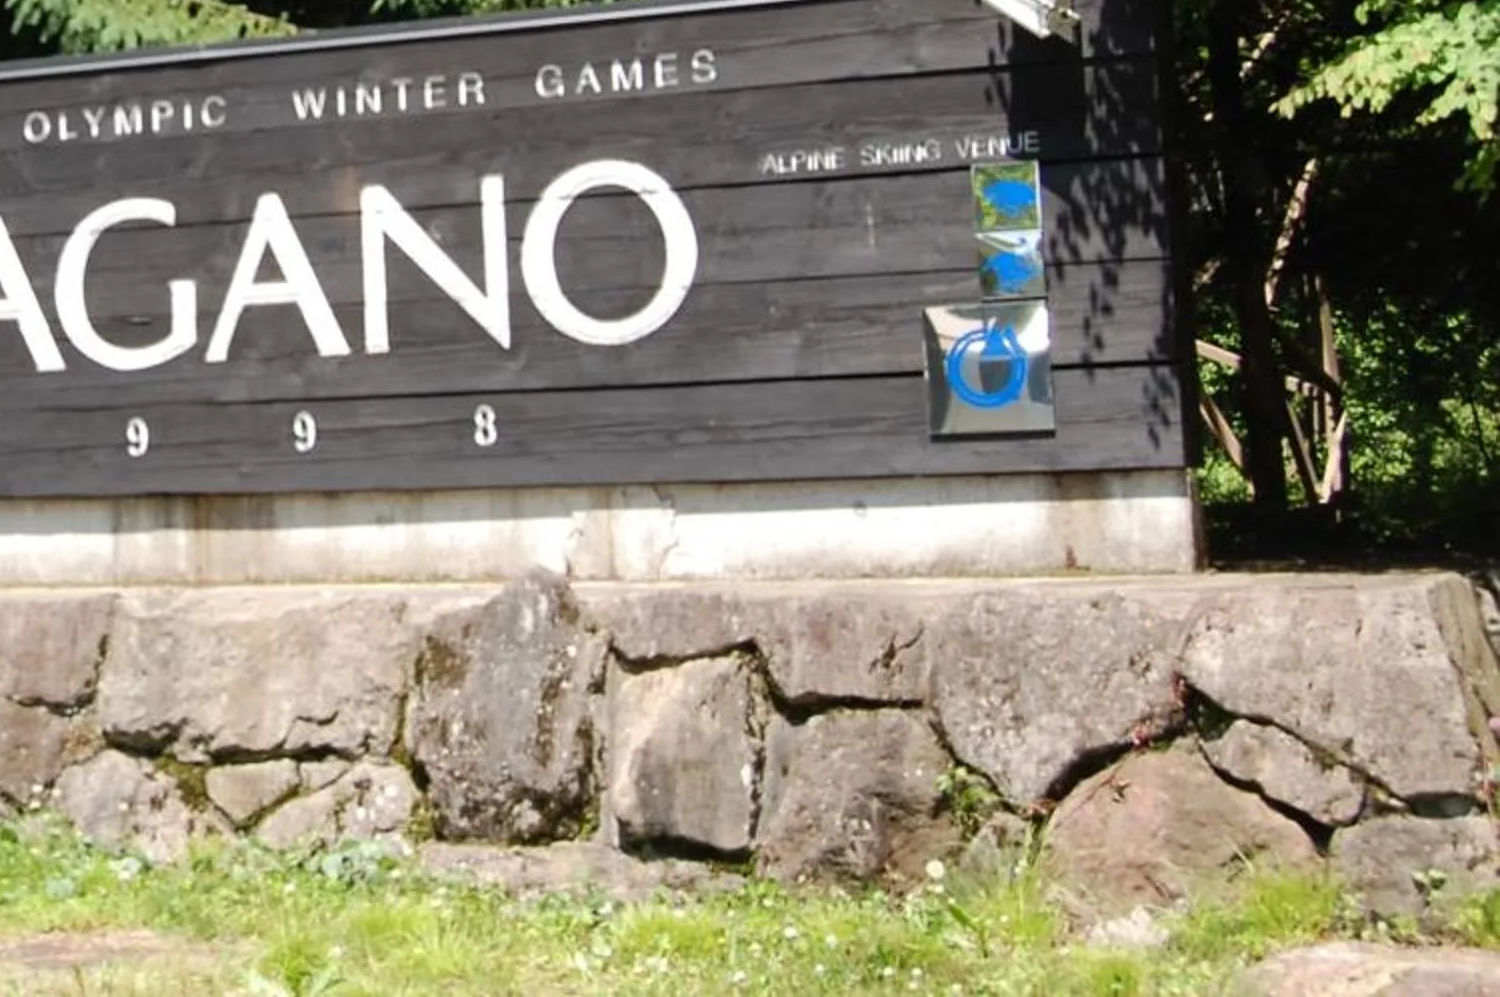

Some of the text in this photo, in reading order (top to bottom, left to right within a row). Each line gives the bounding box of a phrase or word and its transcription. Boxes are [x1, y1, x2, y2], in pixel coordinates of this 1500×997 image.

[22, 94, 228, 144] OLYMPIC
[291, 71, 487, 121] WINTER
[533, 49, 719, 99] GAMES
[759, 130, 1041, 175] ALPINE SKIING VENUE
